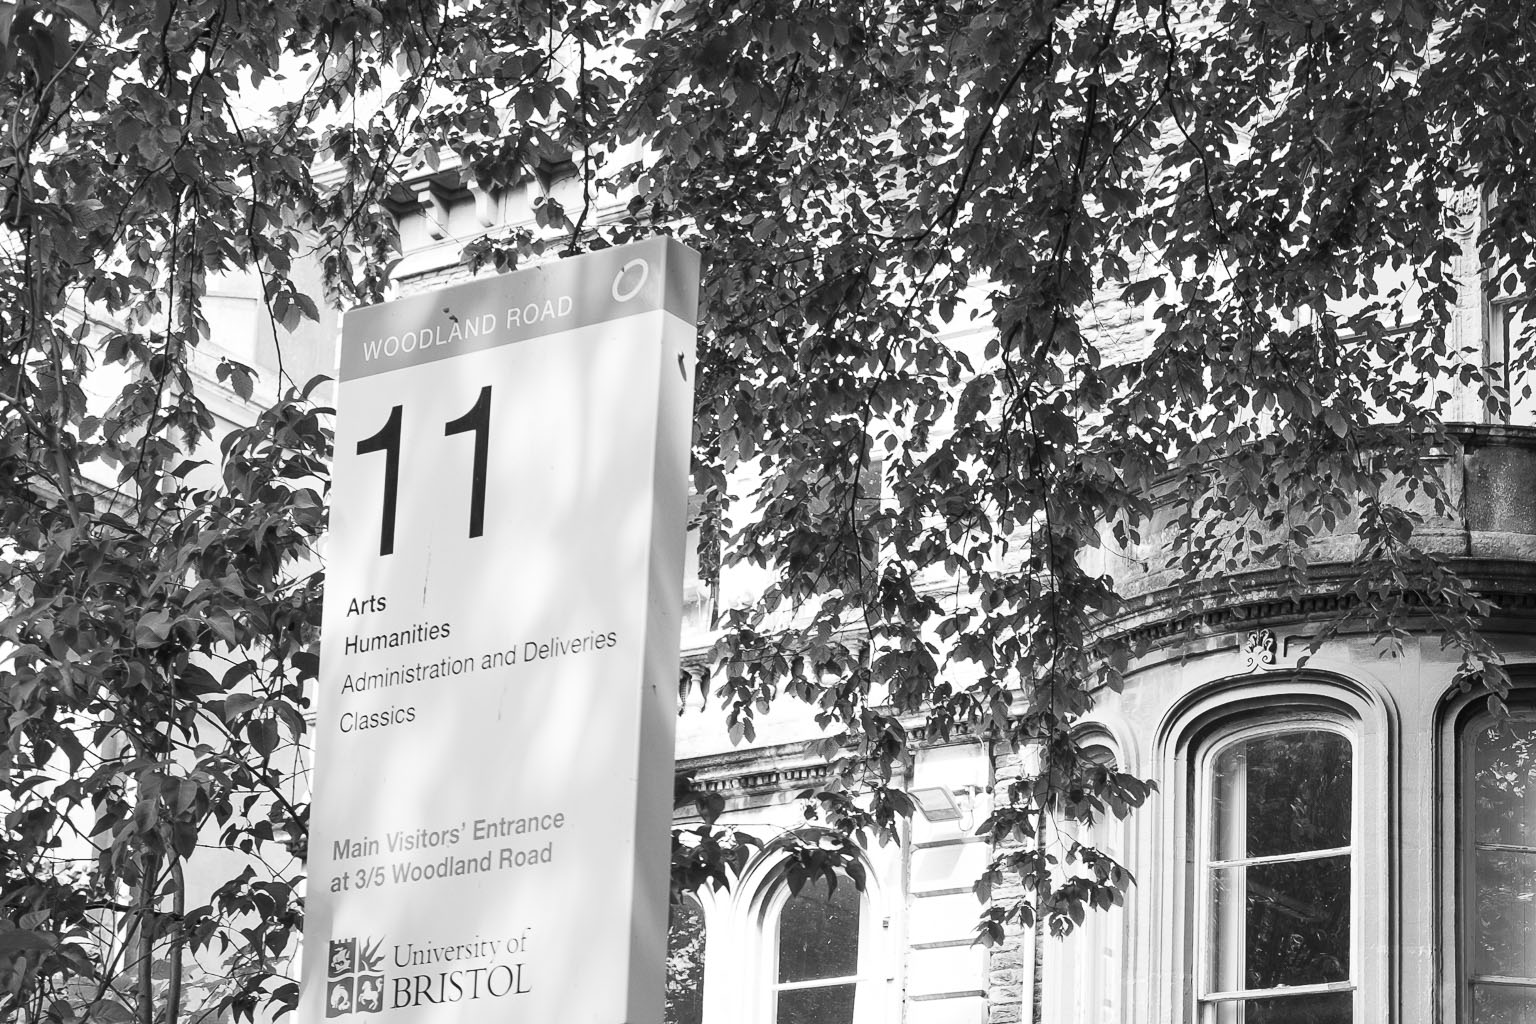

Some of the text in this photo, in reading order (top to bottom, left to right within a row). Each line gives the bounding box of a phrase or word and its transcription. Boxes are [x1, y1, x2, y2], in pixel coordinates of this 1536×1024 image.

[363, 296, 574, 362] WOODLAND ROAD
[356, 385, 492, 556] 11
[346, 594, 387, 617] Arts
[341, 630, 617, 694] Administration and Deliveries
[344, 621, 451, 656] Humanities
[339, 705, 416, 733] Classics
[332, 836, 380, 861] Main
[473, 811, 565, 841] Entrance
[330, 841, 553, 893] at 3/5 Woodland Road
[393, 927, 532, 968] University of
[390, 963, 532, 1009] BRISTOL
